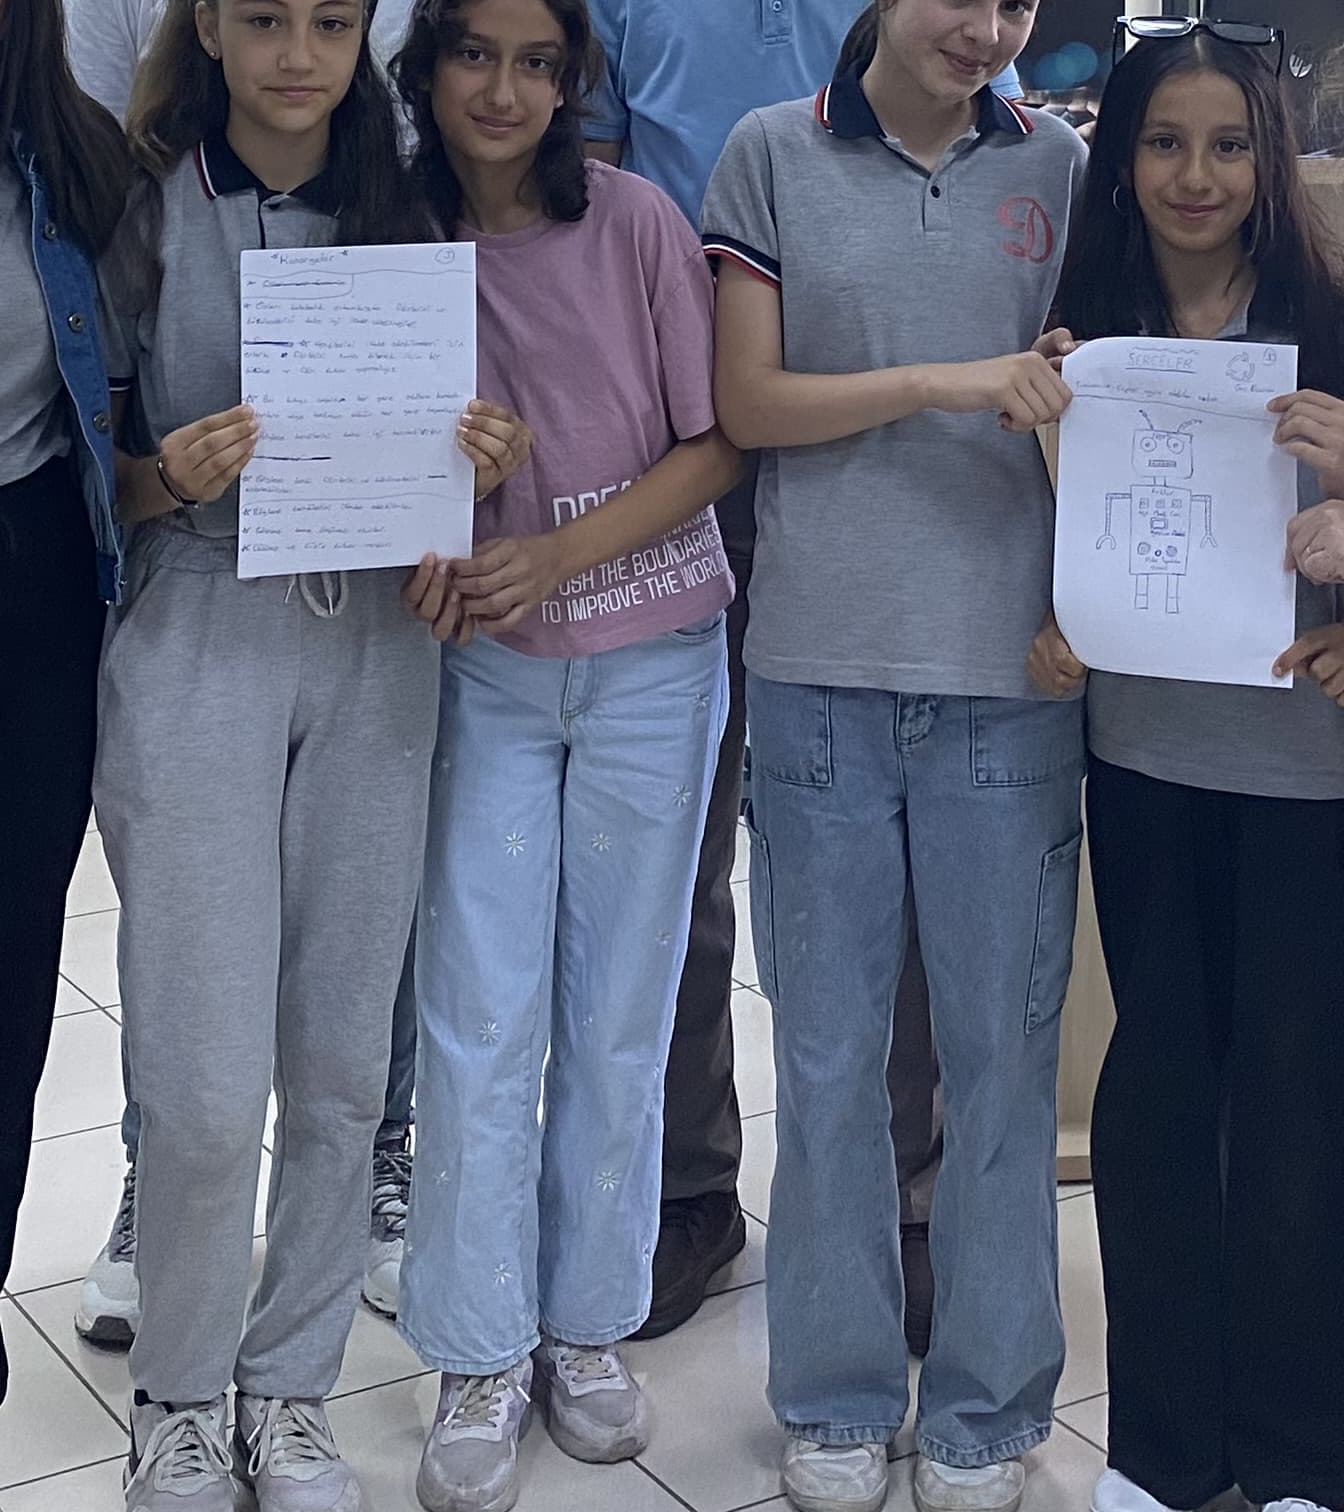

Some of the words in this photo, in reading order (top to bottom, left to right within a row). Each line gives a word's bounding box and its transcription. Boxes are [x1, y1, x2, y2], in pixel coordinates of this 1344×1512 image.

[559, 568, 594, 596] USH
[598, 556, 628, 587] THE
[631, 522, 723, 578] BOUNDARIES
[567, 582, 644, 622] IMPROVE
[644, 570, 681, 600] THE
